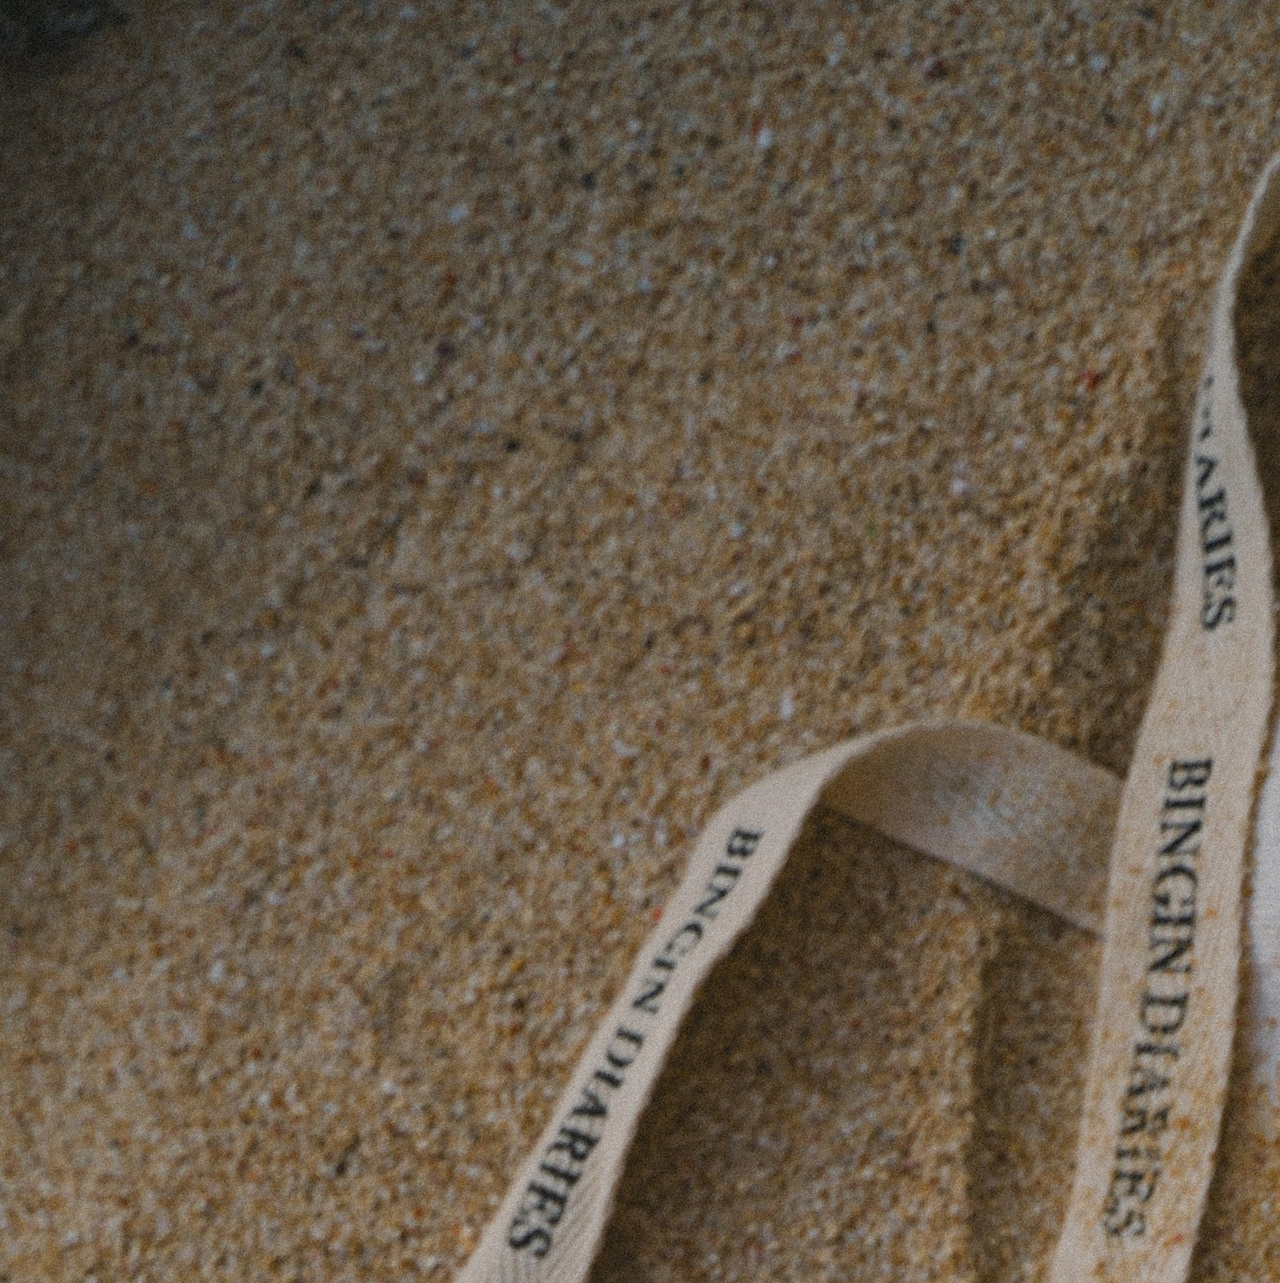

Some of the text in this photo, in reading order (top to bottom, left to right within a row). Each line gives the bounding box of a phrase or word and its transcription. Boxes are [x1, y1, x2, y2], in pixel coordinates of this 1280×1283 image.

[1195, 375, 1236, 630] ARIES
[508, 826, 767, 1258] BINGIN DIARIES
[1103, 759, 1213, 1239] BINGIN DIARIES
